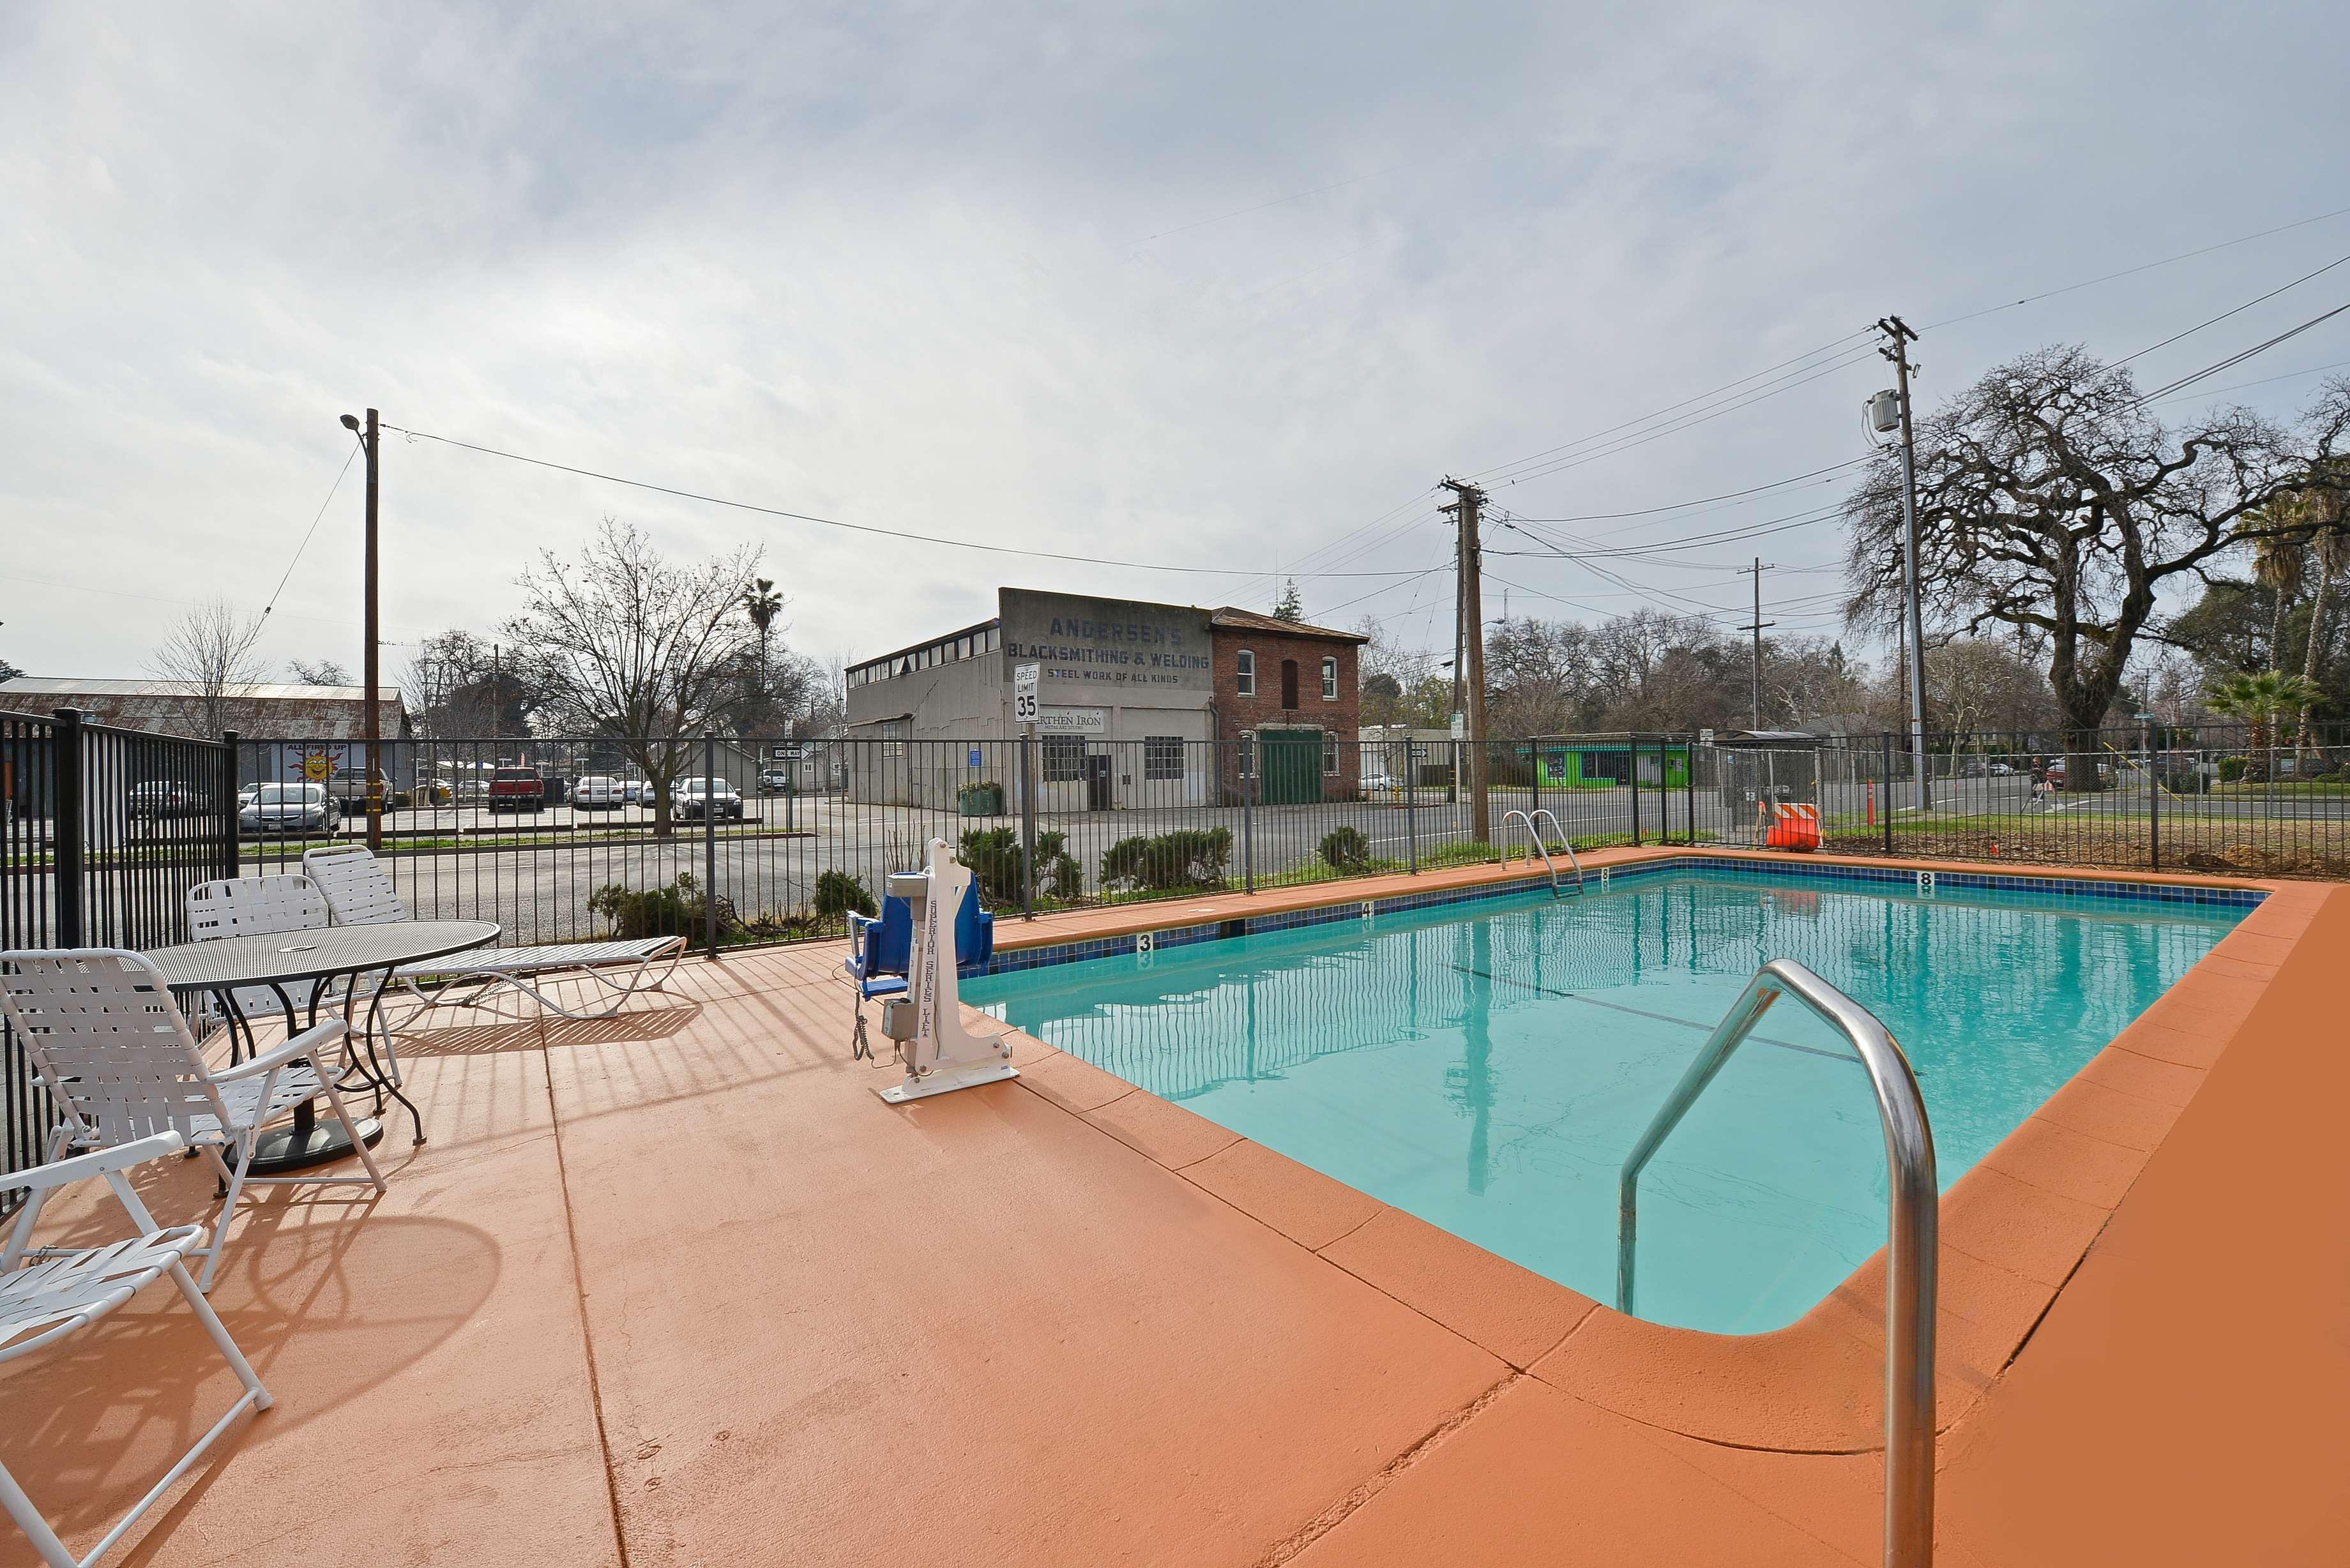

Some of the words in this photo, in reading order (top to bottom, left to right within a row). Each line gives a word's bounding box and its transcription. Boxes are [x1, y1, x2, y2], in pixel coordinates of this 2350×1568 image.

[1049, 617, 1181, 645] ANDERSEN'S
[1008, 643, 1129, 665] BLACKSMITHING
[1134, 652, 1146, 665] &
[1150, 653, 1209, 669] WELDING
[1016, 670, 1037, 681] SPEED
[1047, 668, 1079, 679] STEEL
[1083, 670, 1112, 681] WORK
[1116, 672, 1128, 681] OF
[1131, 673, 1148, 682] ALL
[1151, 674, 1178, 683] KINDS
[1017, 682, 1035, 693] LIMIT
[1017, 695, 1036, 717] 35
[1037, 716, 1073, 725] RTHEN
[1603, 868, 1608, 880] 8
[1921, 872, 1932, 886] 8
[926, 900, 937, 955] SUPERIOR
[1139, 934, 1151, 952] 3
[923, 961, 934, 1002] SERIES
[921, 1008, 930, 1037] LIFT
